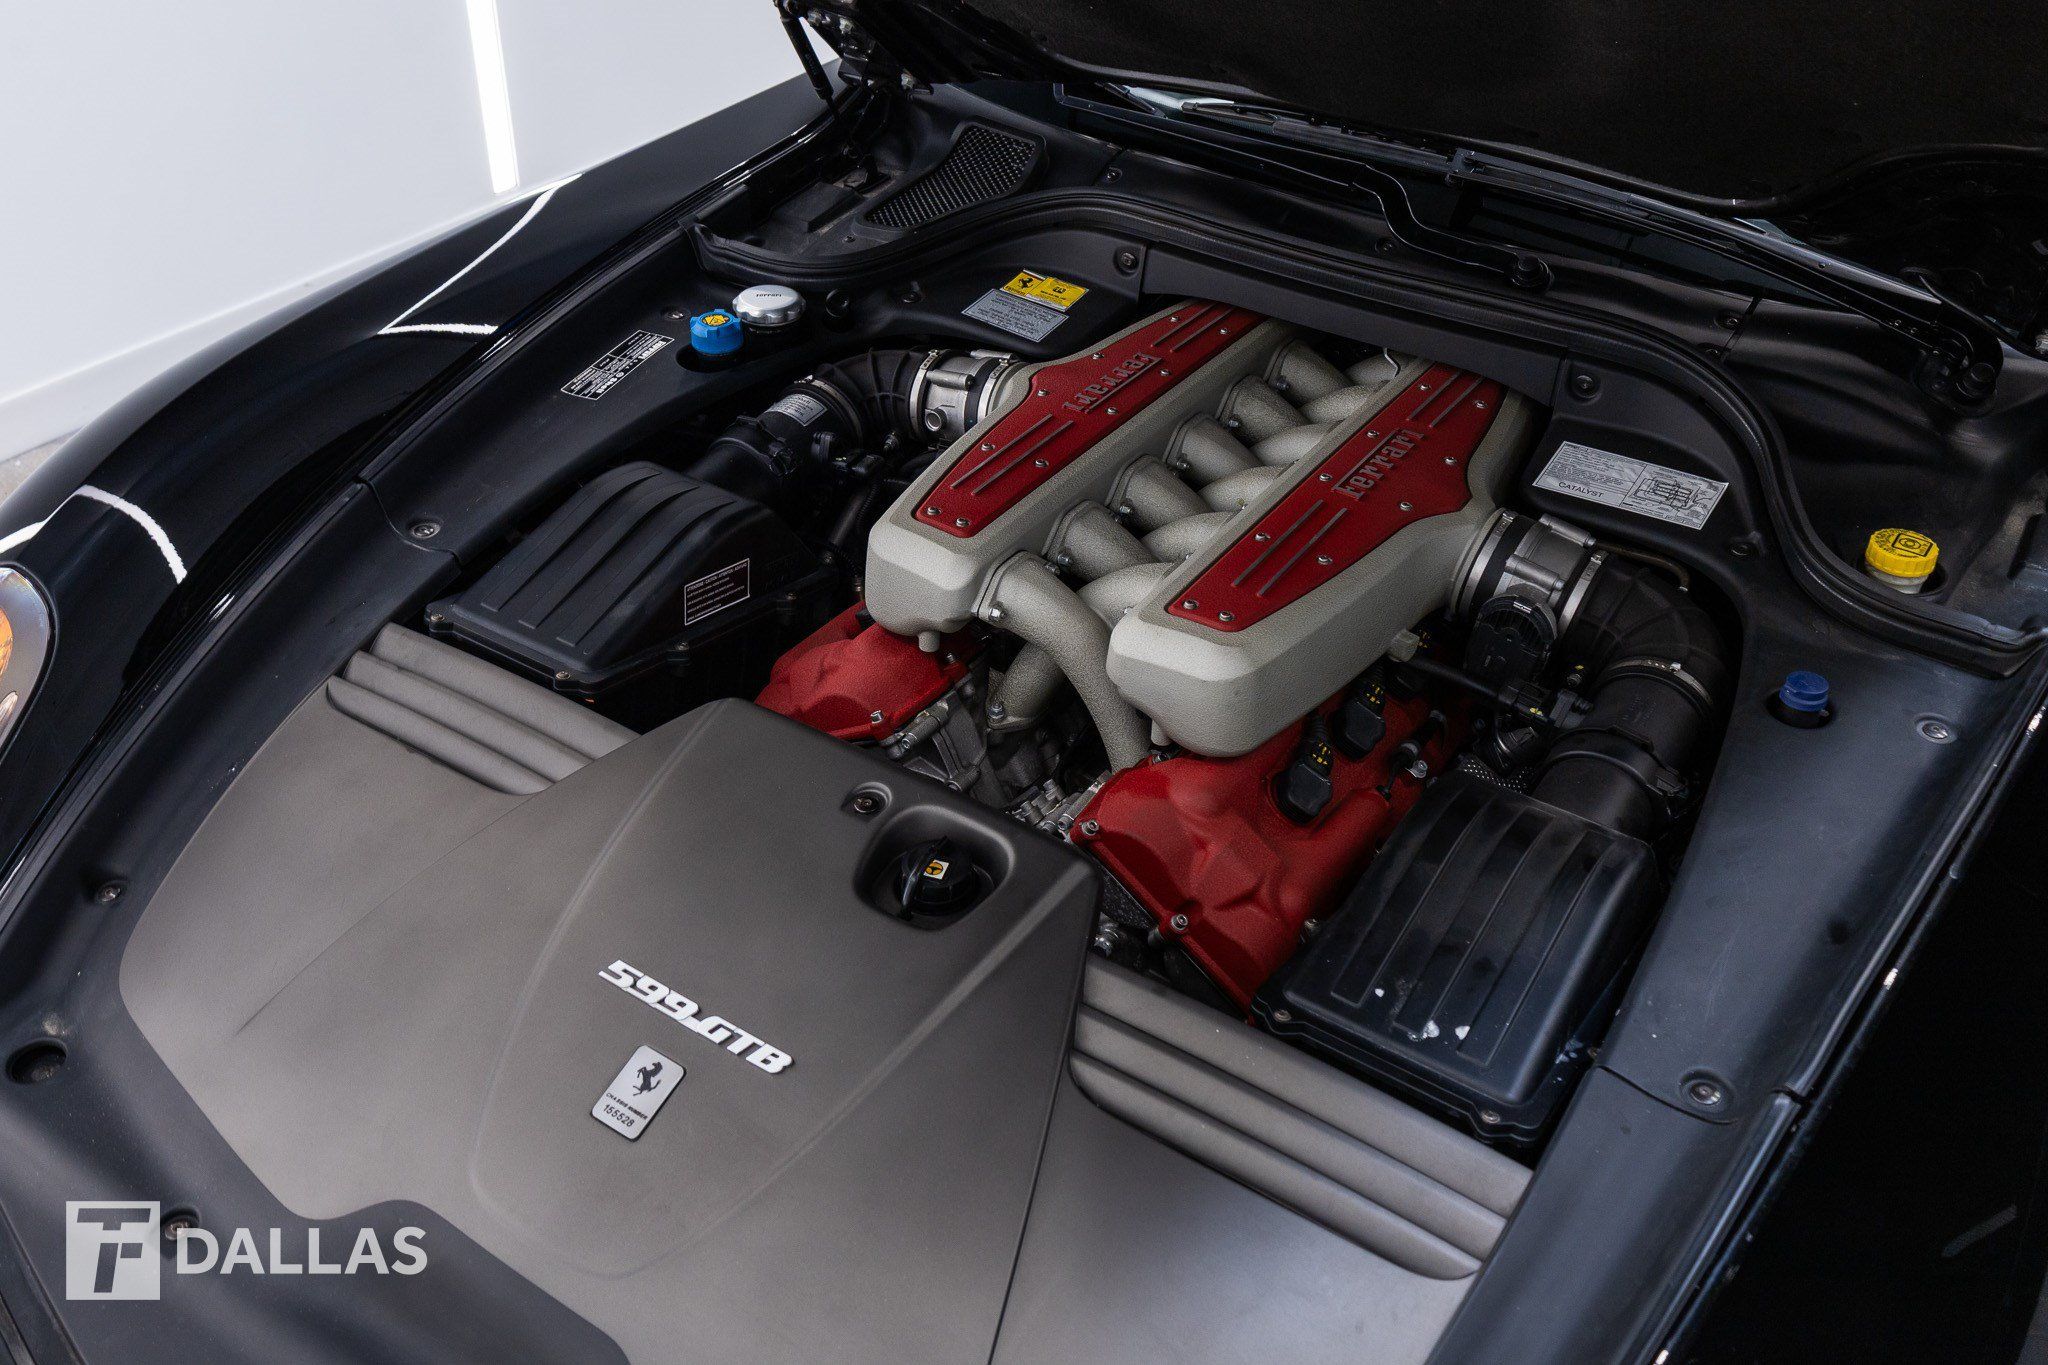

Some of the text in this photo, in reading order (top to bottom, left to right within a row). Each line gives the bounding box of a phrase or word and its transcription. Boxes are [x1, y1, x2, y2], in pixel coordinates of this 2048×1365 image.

[1062, 351, 1162, 413] Ferrari
[1331, 428, 1425, 501] Ferrari
[1558, 481, 1605, 498] CATALYST
[598, 959, 794, 1074] 599 GTB
[603, 1104, 635, 1127] 155528
